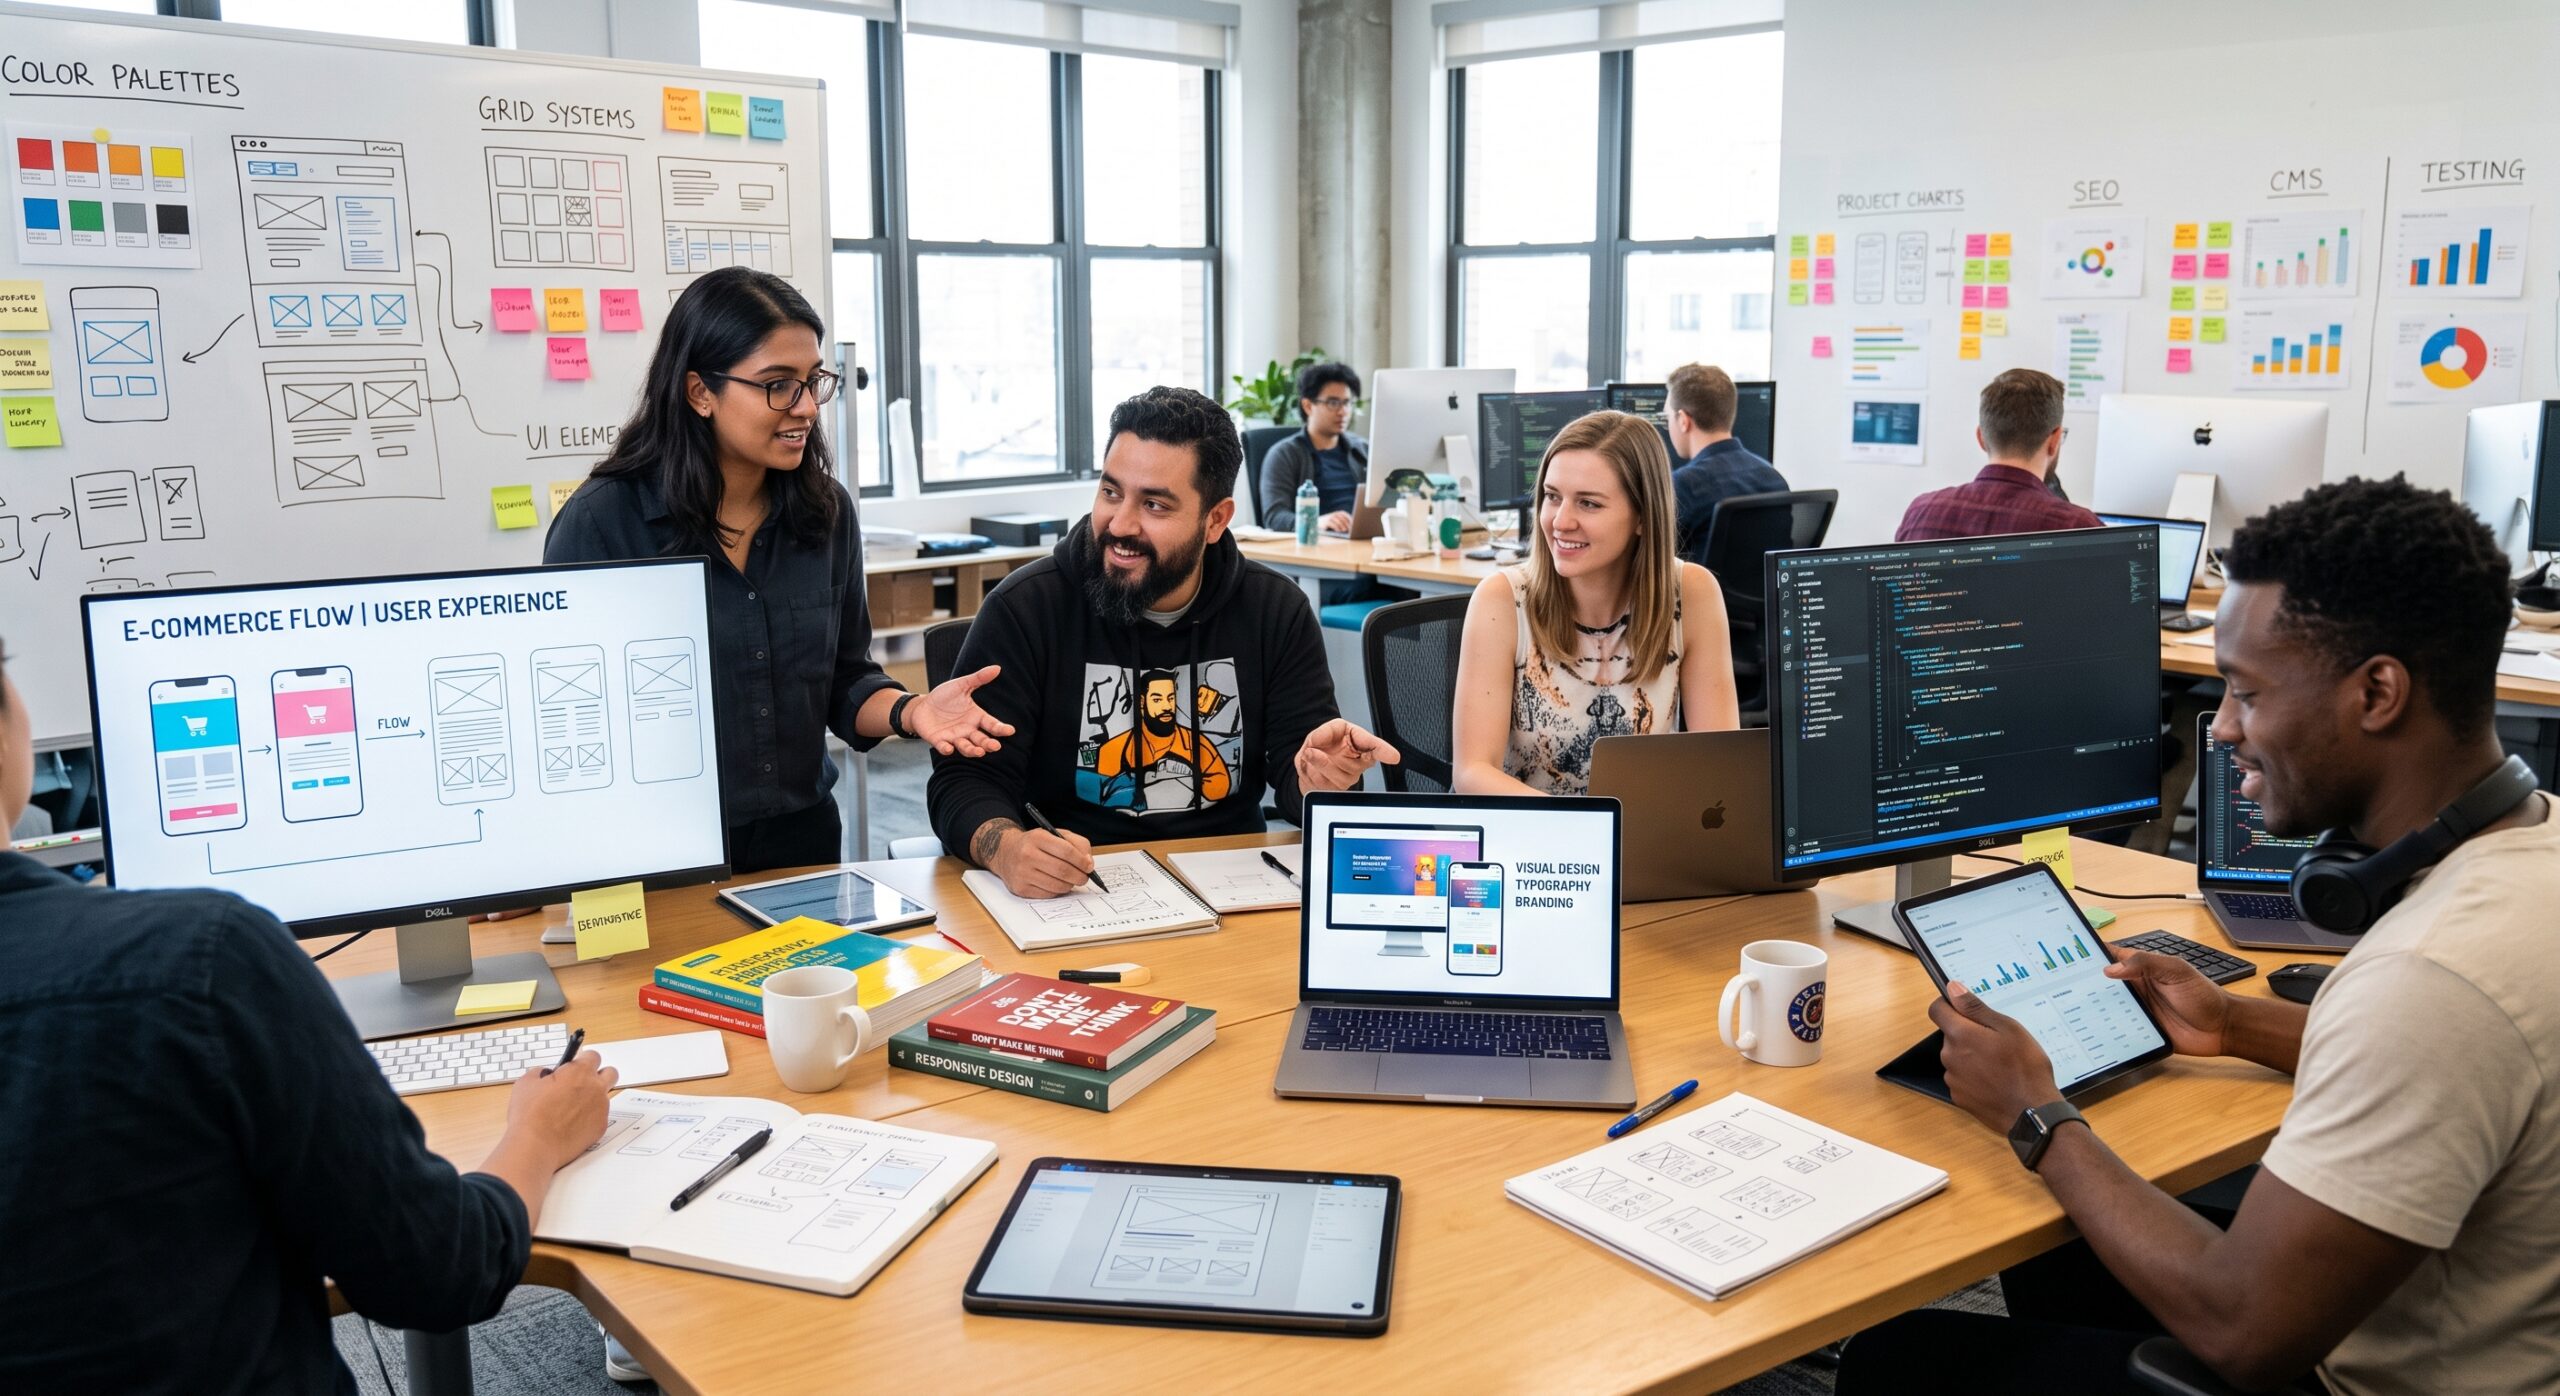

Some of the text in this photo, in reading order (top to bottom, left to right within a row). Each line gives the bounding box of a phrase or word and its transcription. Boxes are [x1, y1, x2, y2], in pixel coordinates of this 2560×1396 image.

[2, 55, 240, 97] COLOR PALETTES
[479, 96, 635, 129] GRID SYSTEMS
[2270, 168, 2323, 191] CMS
[2421, 159, 2525, 183] TESTING
[1838, 189, 1964, 211] PROJECT CHARTS
[2074, 180, 2119, 202] SEO
[527, 424, 622, 450] UI ELEME
[124, 610, 283, 641] E-COMMERCE
[290, 604, 354, 629] FLOW
[375, 600, 432, 622] USER
[438, 590, 568, 618] EXPERIENCE
[378, 717, 410, 729] FLOW
[1516, 862, 1600, 875] VISUAL DESIGN
[1515, 879, 1591, 892] TYPOGRAPHY
[425, 908, 453, 918] DELL
[1515, 897, 1574, 908] BRANDING
[997, 989, 1066, 1025] DON'T
[1020, 991, 1092, 1030] MAKE
[1055, 1005, 1101, 1027] ME
[1070, 1001, 1142, 1037] THINK
[972, 1033, 1064, 1058] DON'T MAKE ME THINK
[915, 1052, 986, 1078] RESPONSIVE
[989, 1068, 1033, 1088] DESIGN
